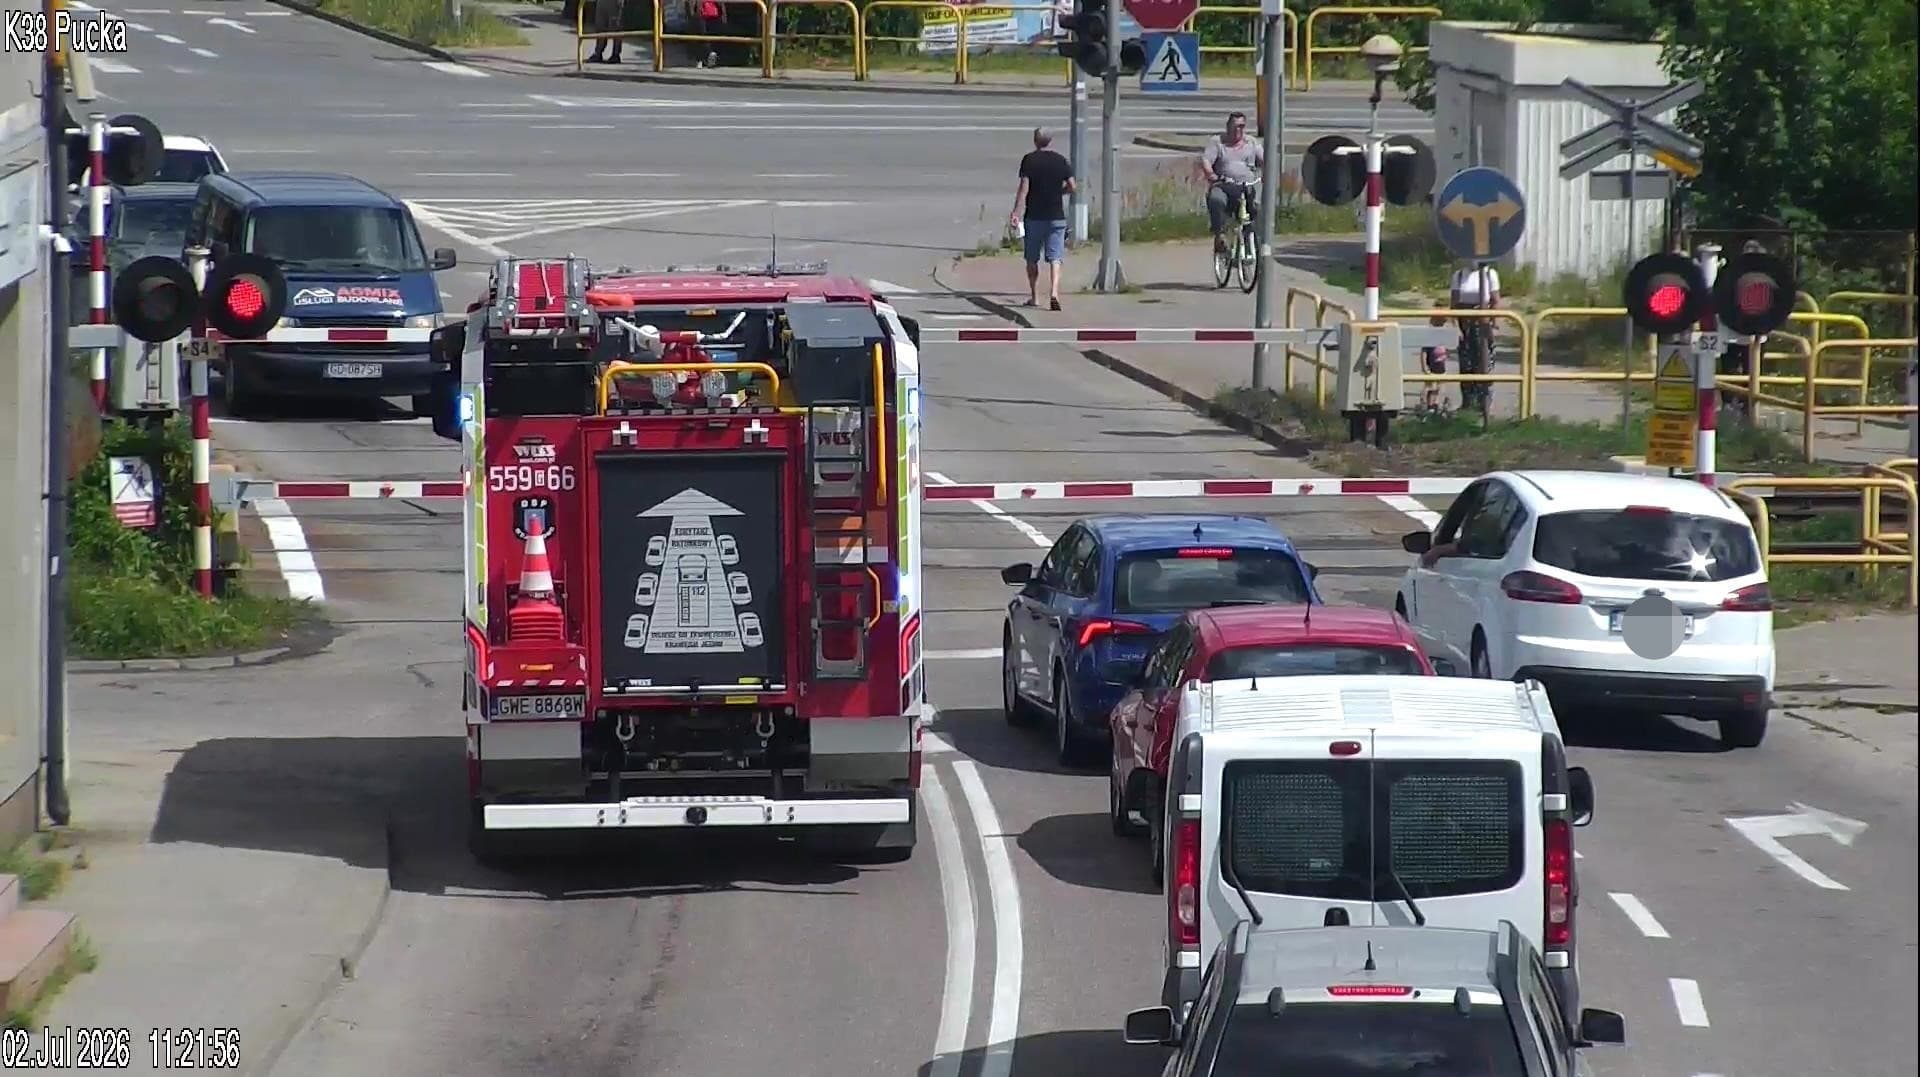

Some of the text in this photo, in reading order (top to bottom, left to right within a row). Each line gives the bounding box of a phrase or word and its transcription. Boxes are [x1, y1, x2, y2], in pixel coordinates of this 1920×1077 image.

[190, 341, 209, 357] S4
[1700, 335, 1718, 350] S2
[692, 585, 706, 596] 112
[500, 696, 583, 714] GWE 8868W
